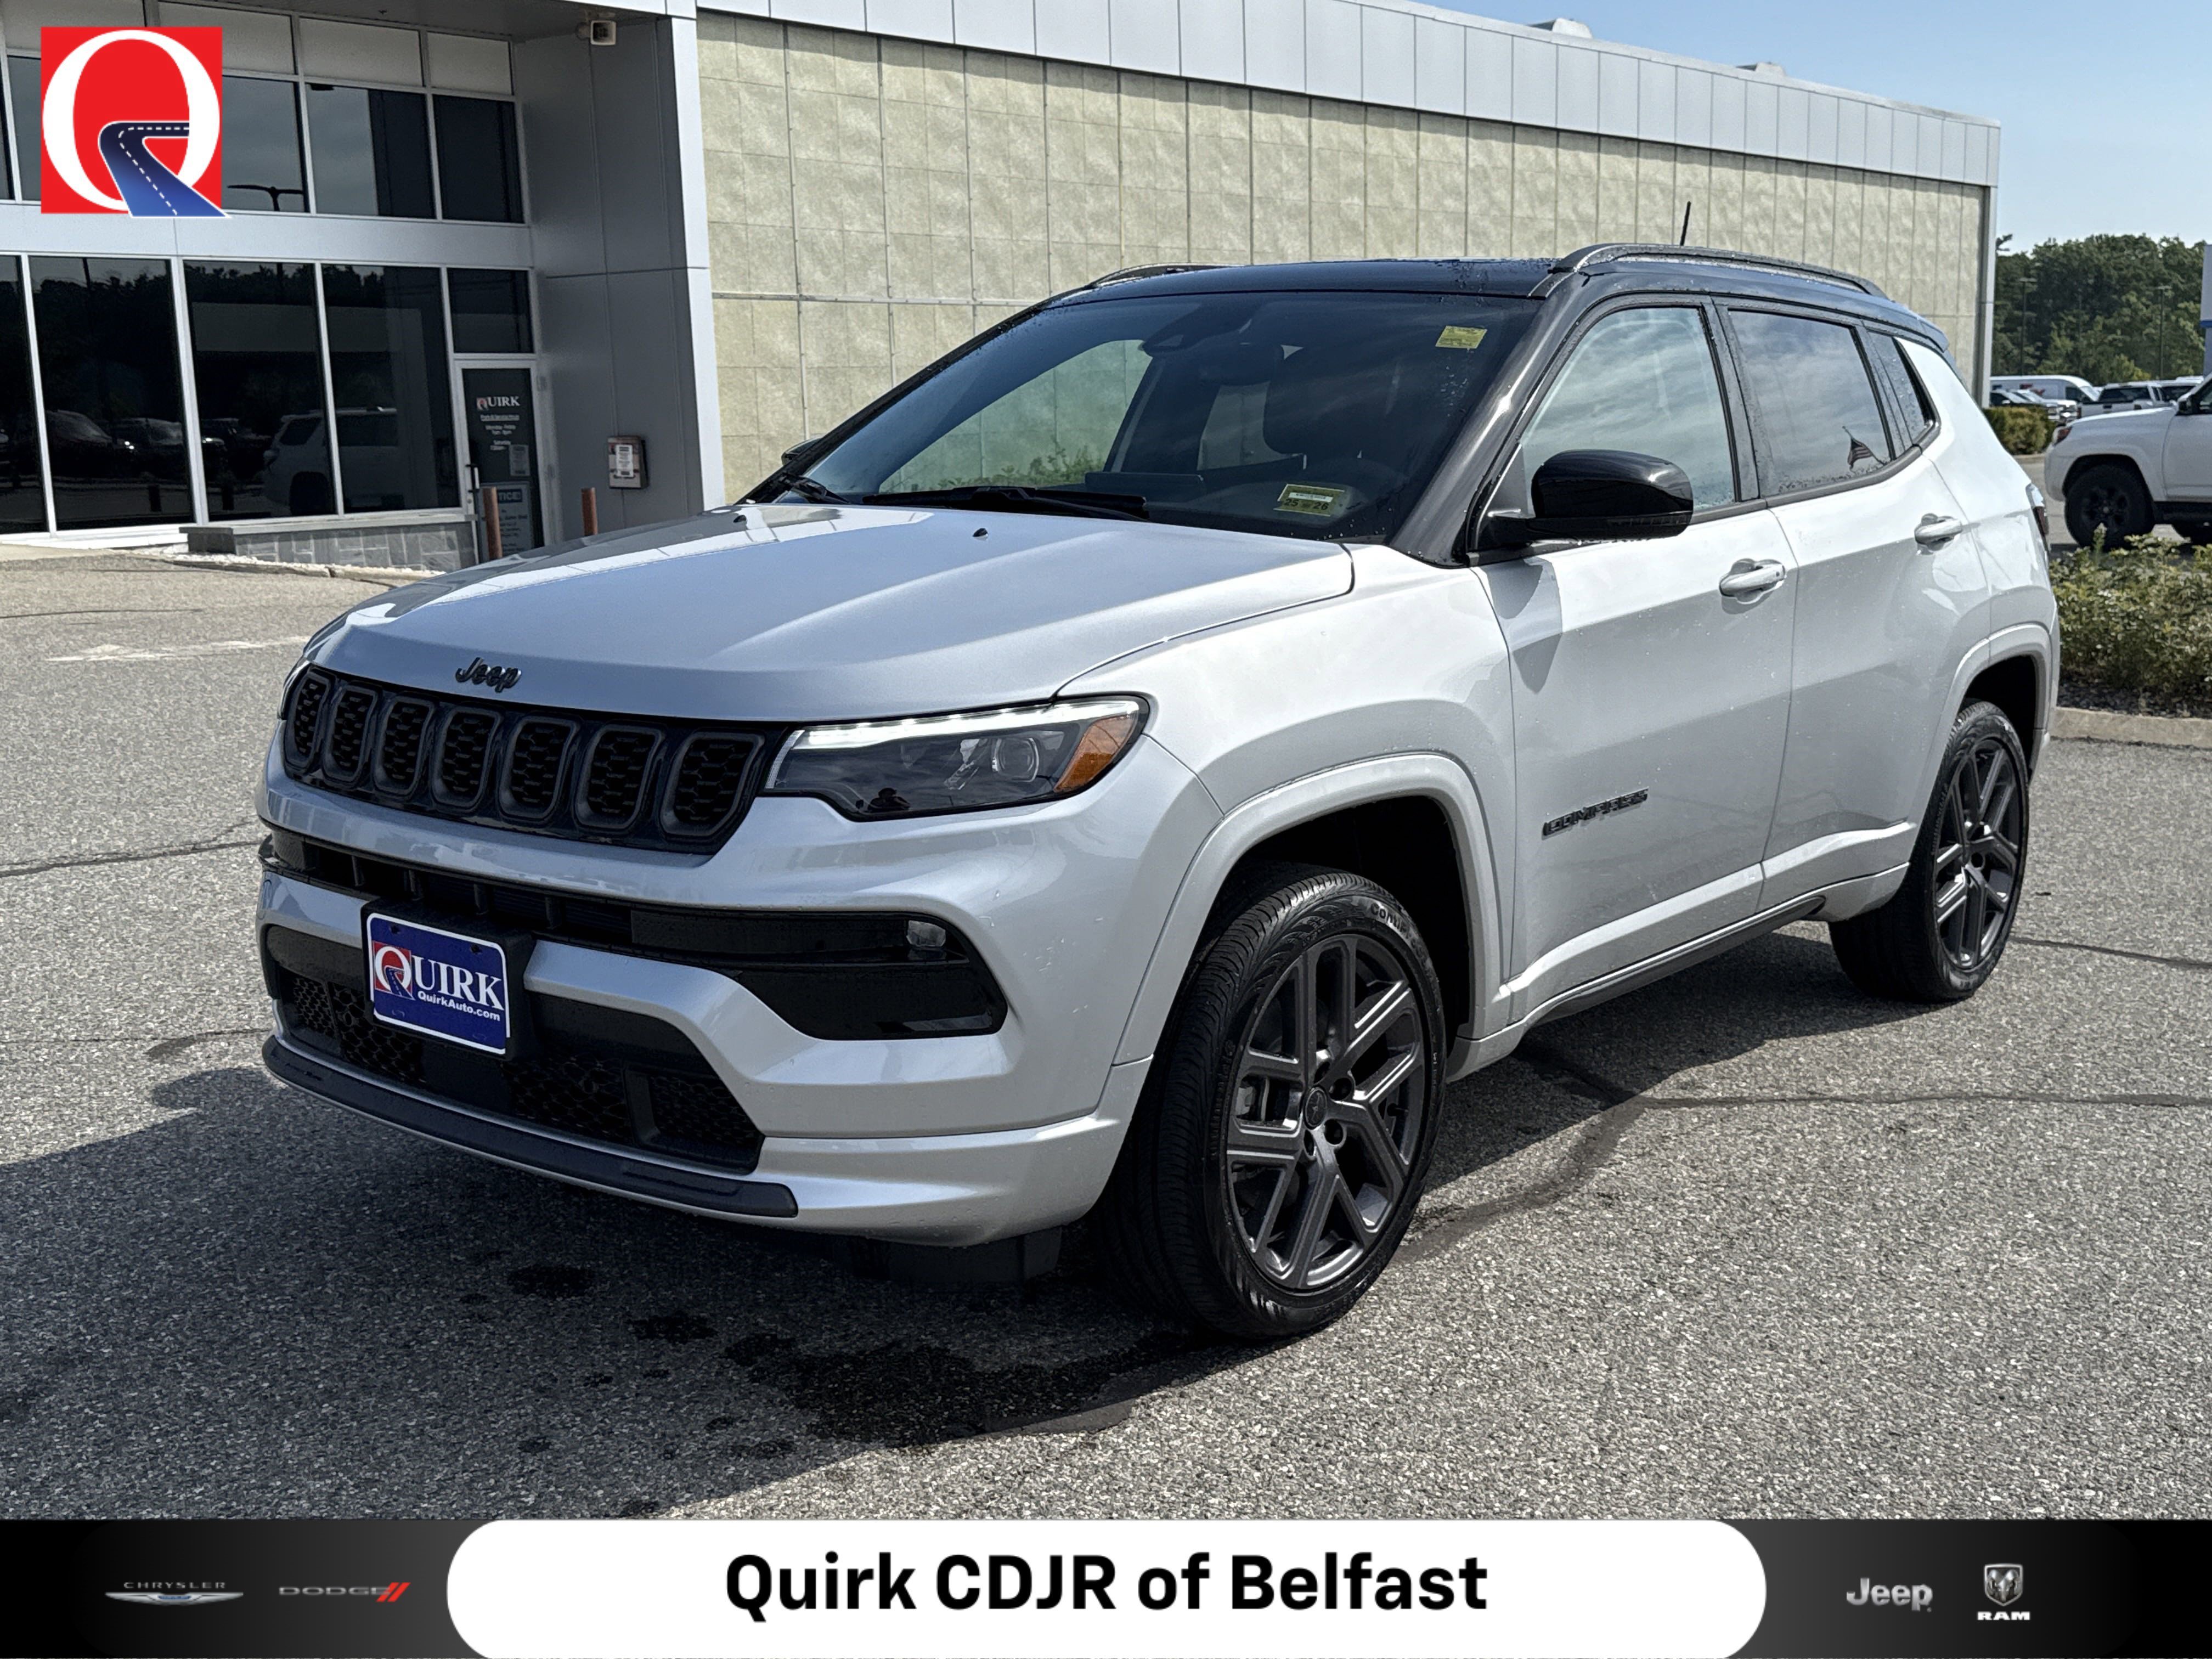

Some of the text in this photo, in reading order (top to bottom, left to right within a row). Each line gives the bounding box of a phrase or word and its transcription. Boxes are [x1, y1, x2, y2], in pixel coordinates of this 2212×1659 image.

[476, 396, 521, 410] QUIRK
[455, 657, 521, 693] Jeep
[374, 946, 505, 1011] QUIRK
[417, 990, 501, 1022] QuirkAuto.com
